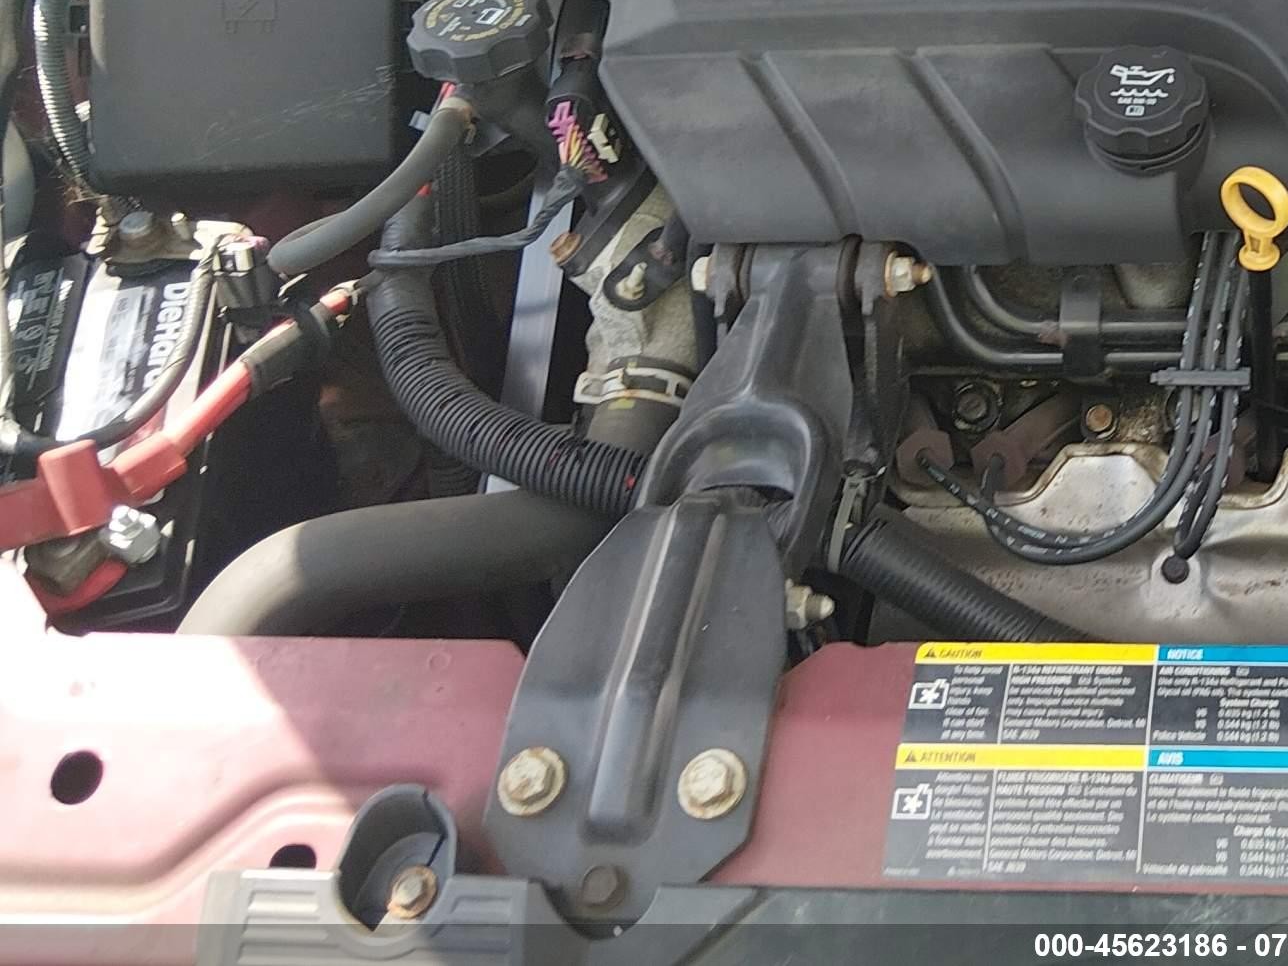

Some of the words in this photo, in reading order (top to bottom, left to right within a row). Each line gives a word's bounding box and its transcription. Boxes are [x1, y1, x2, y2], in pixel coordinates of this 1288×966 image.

[939, 649, 983, 659] CAUTION
[1166, 649, 1203, 660] NOTICE
[920, 752, 977, 763] ATTENTION
[1157, 752, 1184, 765] AVIS
